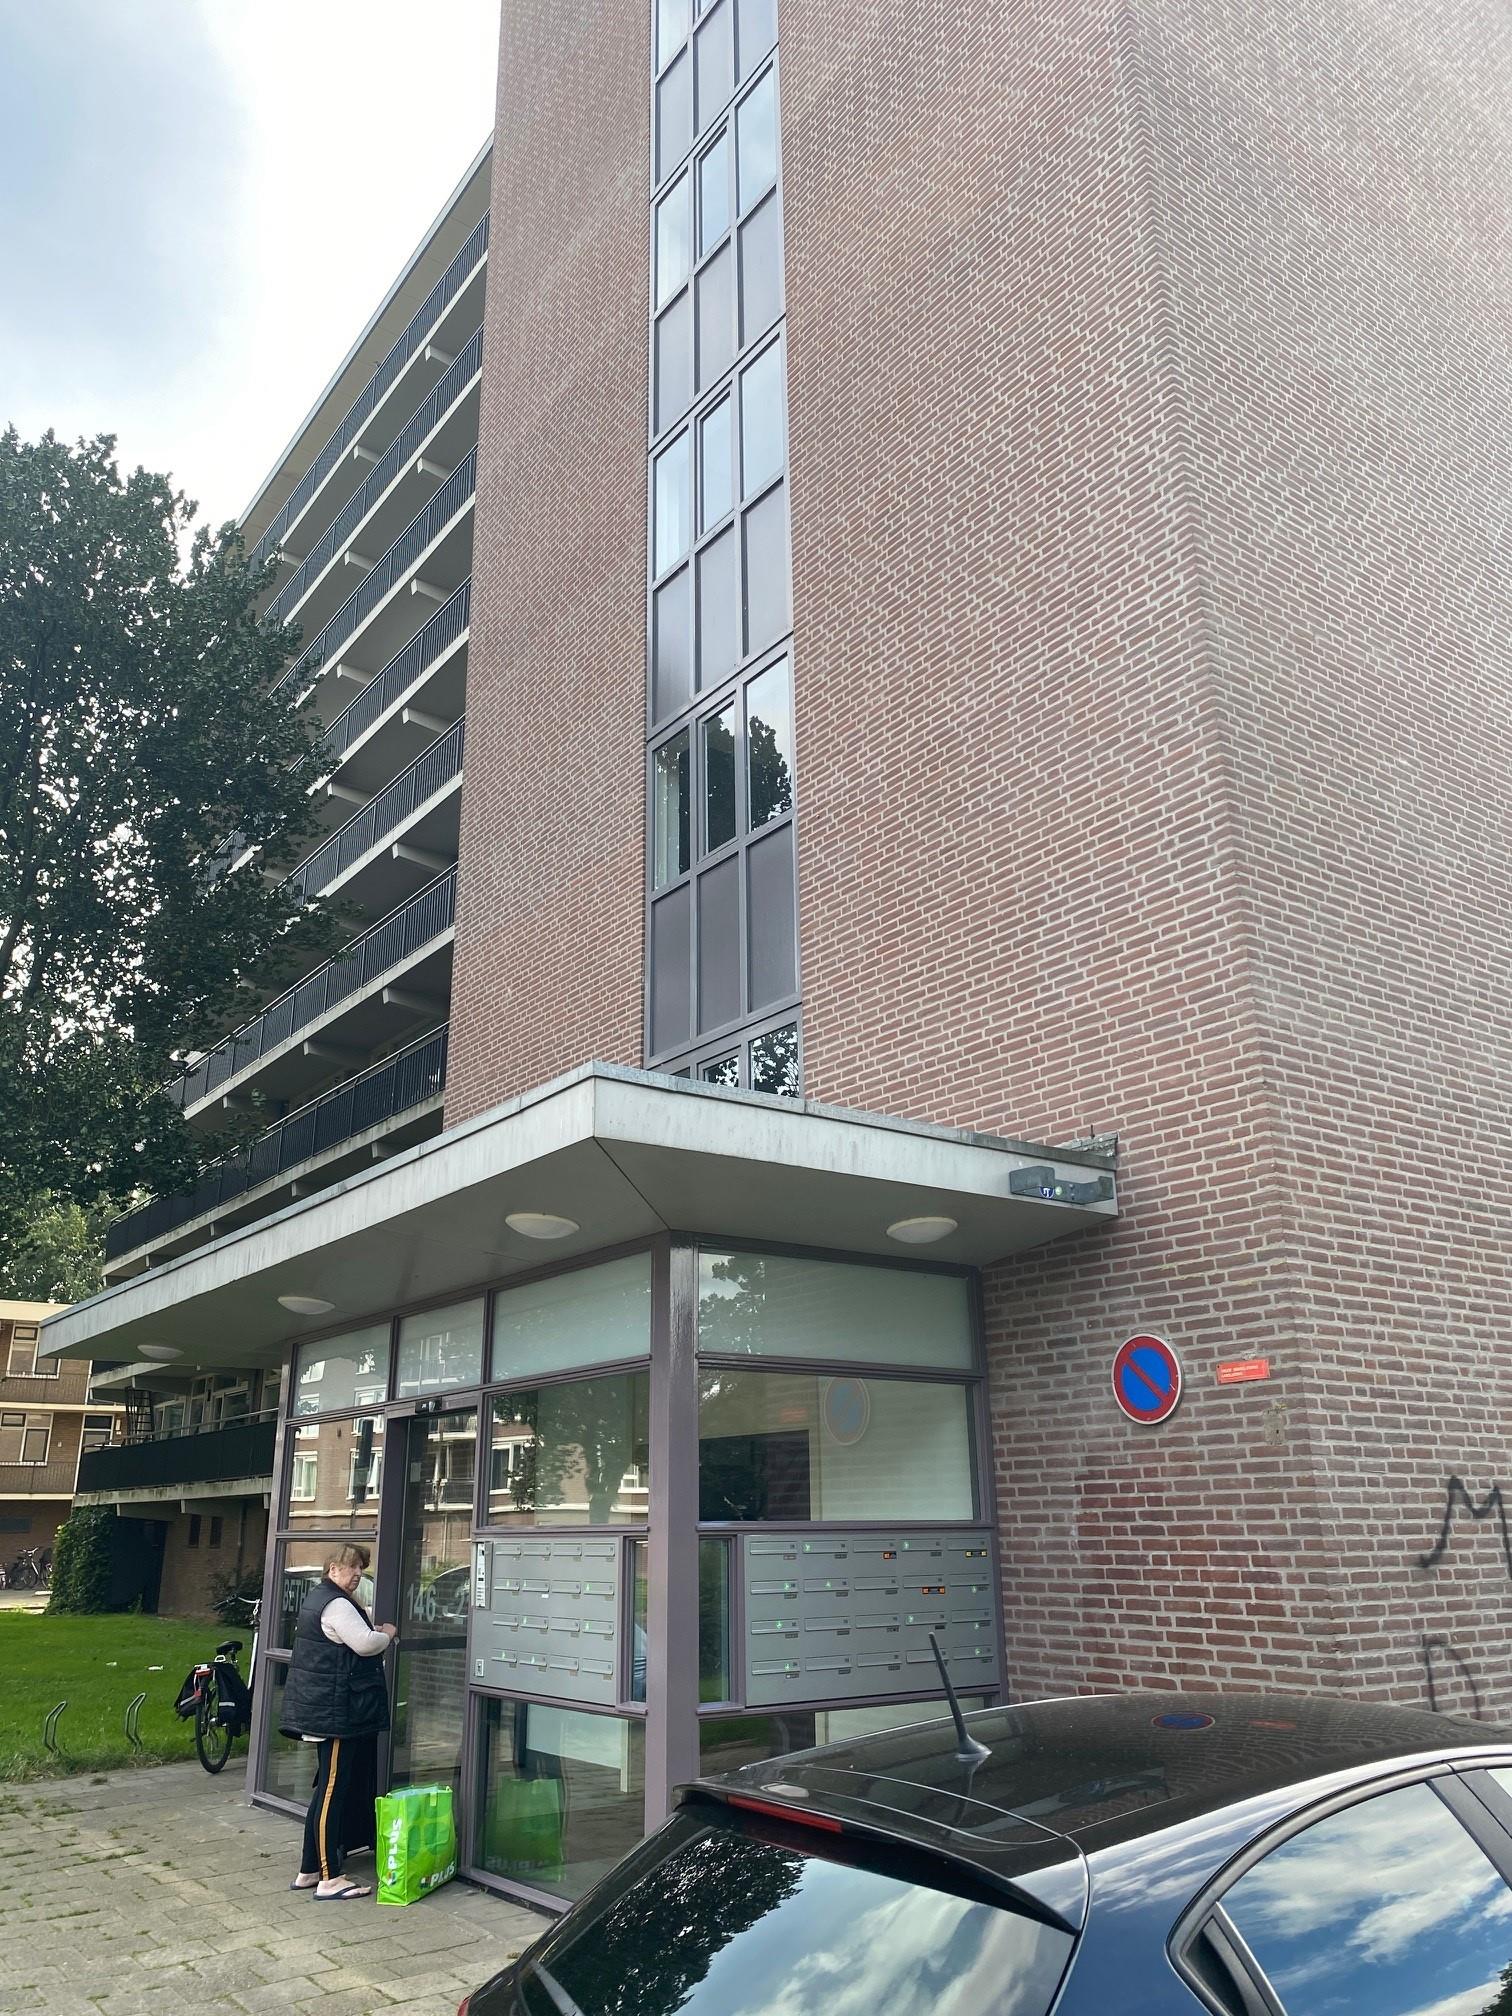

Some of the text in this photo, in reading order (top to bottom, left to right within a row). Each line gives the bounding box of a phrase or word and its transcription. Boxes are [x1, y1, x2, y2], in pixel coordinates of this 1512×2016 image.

[282, 1579, 311, 1612] BETH
[407, 1583, 437, 1622] 146
[387, 1818, 403, 1870] PLUS
[430, 1861, 456, 1888] PLUS
